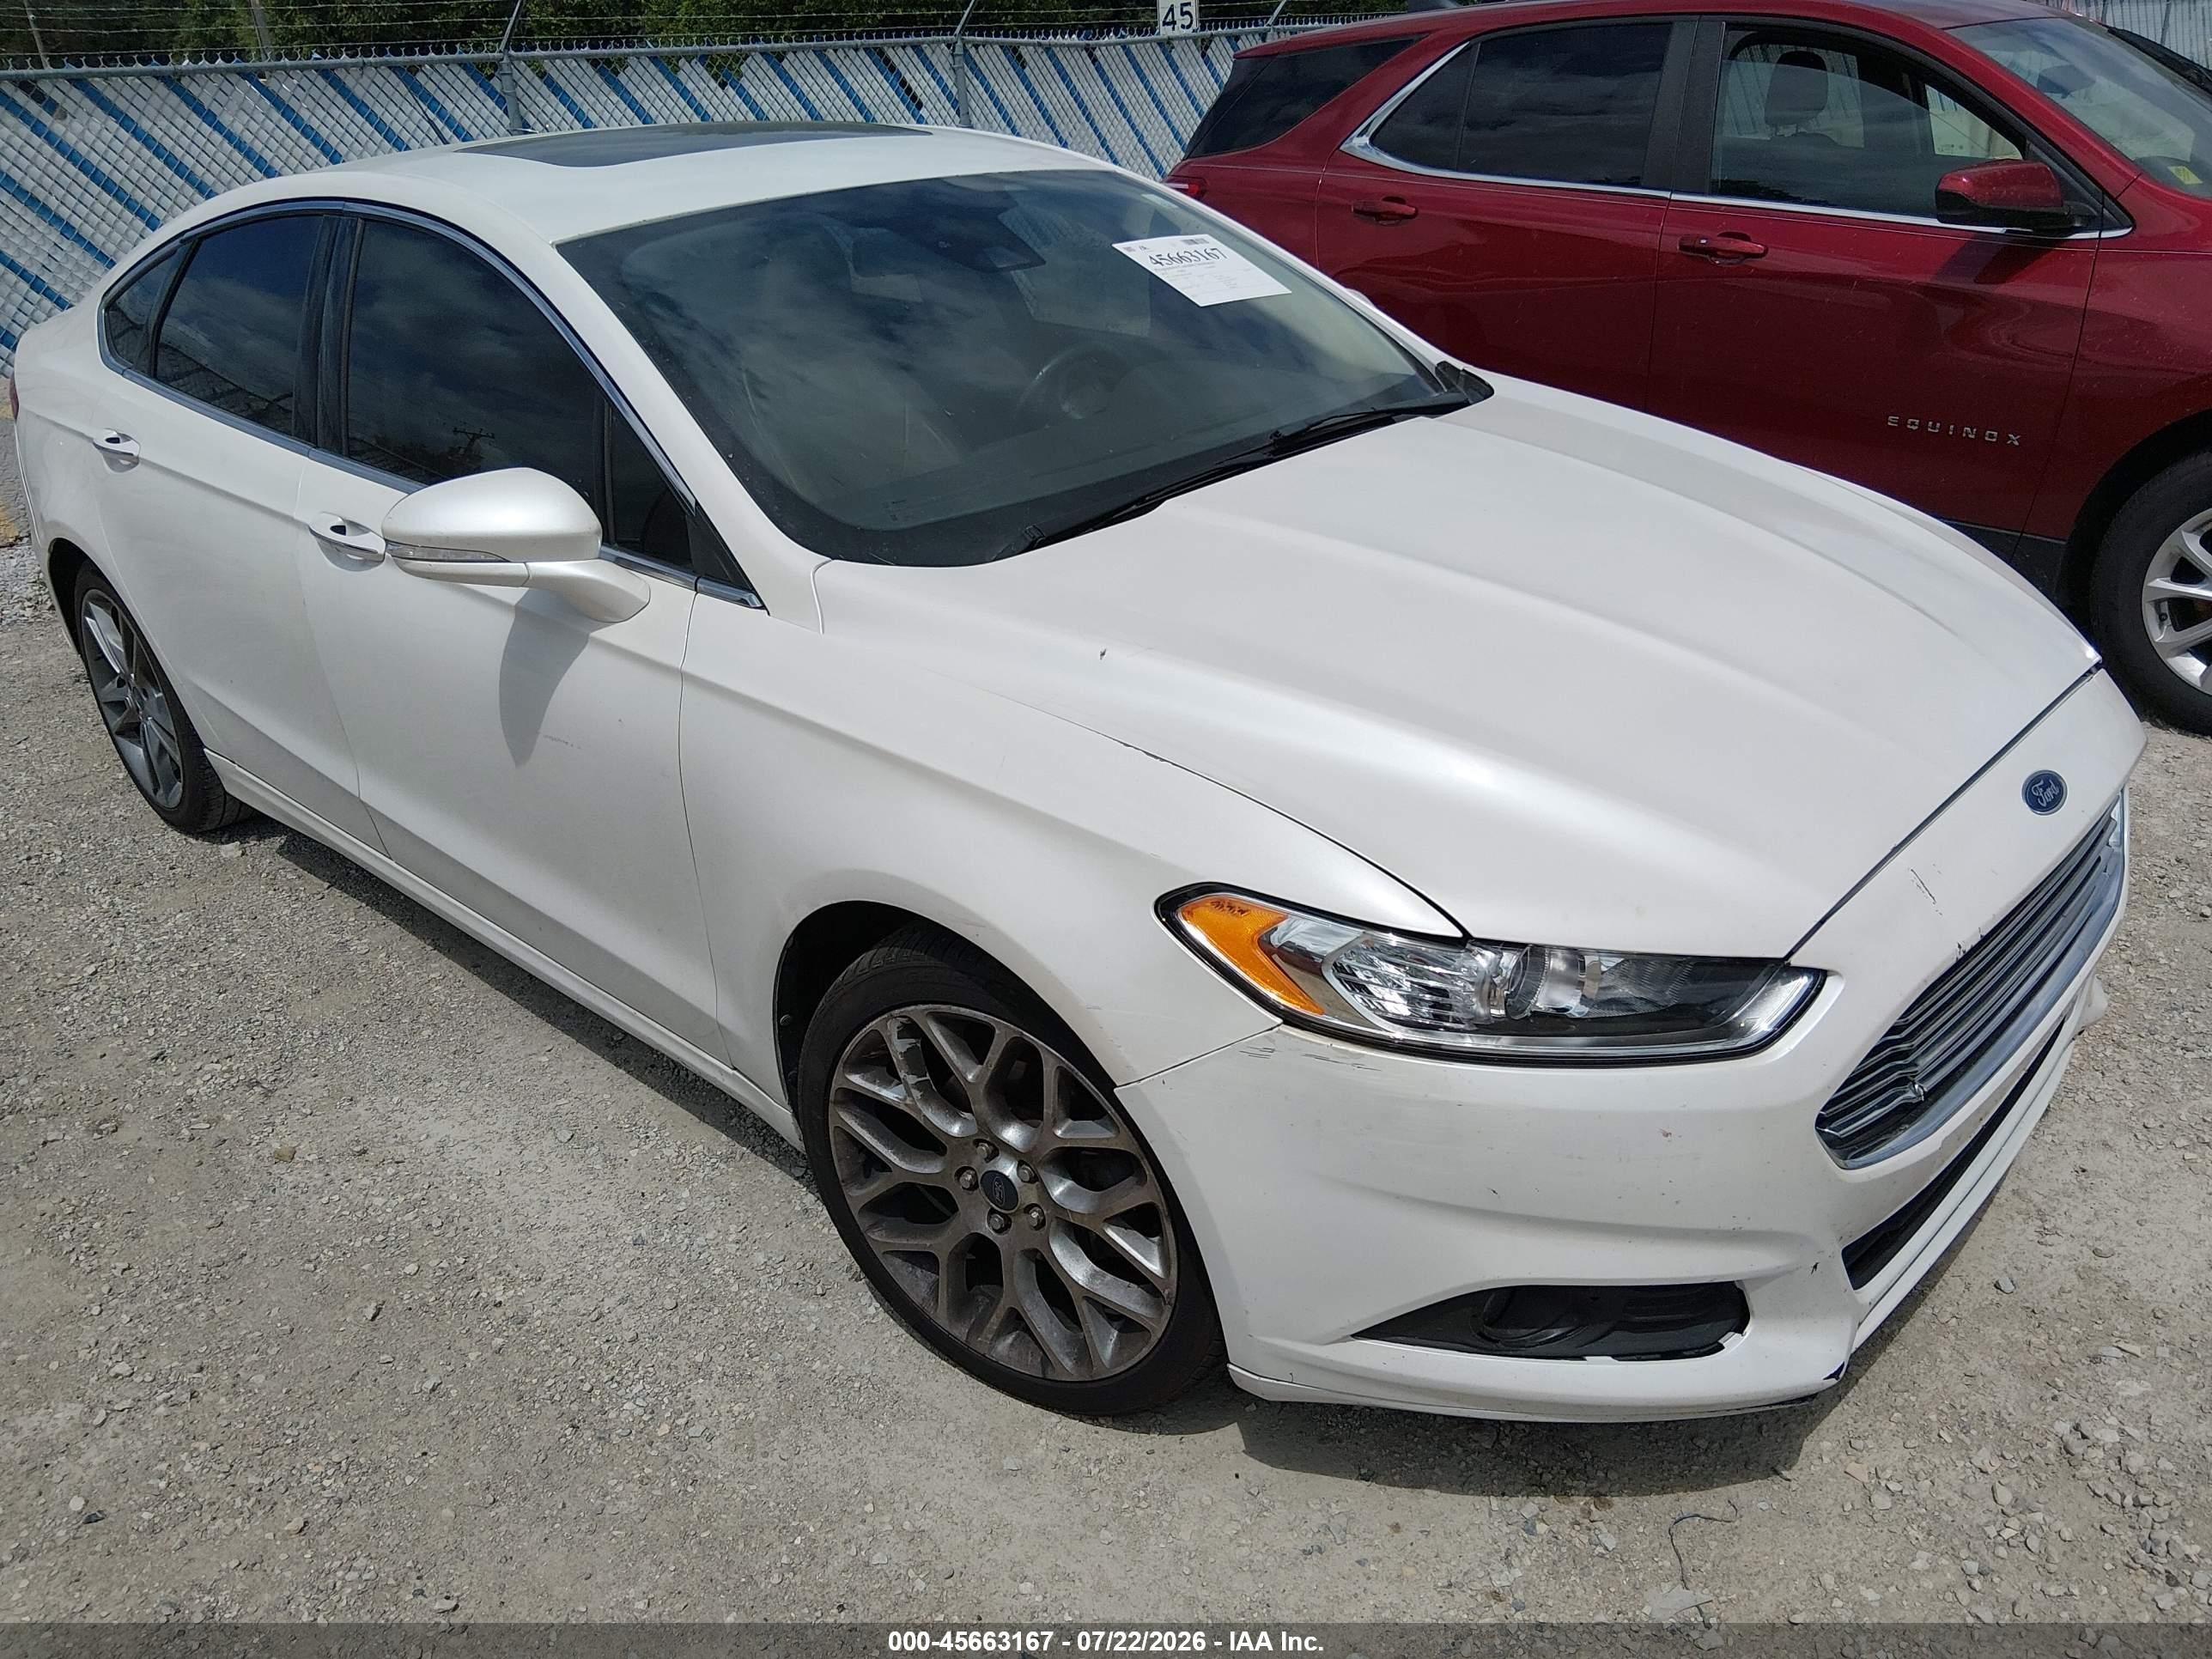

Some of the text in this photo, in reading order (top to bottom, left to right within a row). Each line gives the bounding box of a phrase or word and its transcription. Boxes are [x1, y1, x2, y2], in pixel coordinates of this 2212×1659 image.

[1162, 2, 1194, 31] 45
[1148, 247, 1228, 266] 45663167
[1887, 416, 2021, 446] EQUINOX
[2032, 779, 2060, 807] Ford
